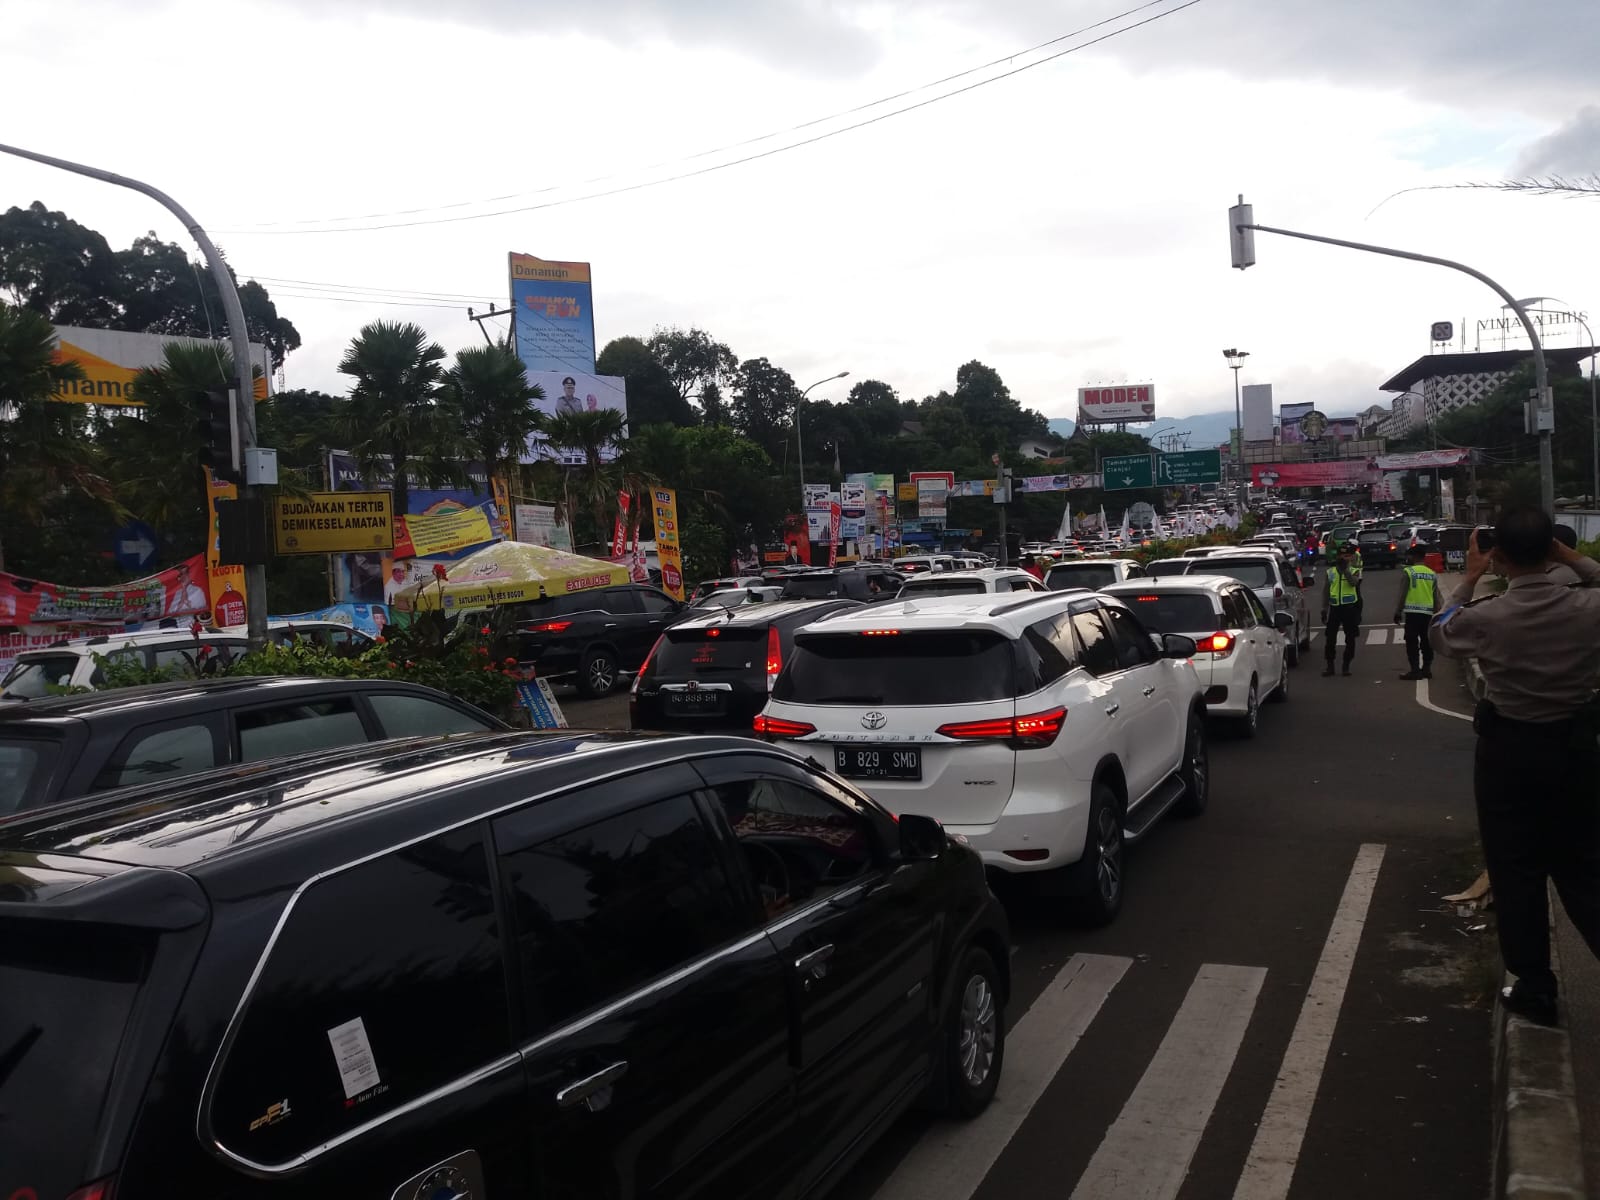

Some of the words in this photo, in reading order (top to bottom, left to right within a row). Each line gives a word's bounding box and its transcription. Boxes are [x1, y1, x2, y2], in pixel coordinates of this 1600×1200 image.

[515, 264, 569, 278] Danamon
[1084, 387, 1149, 406] MODEN
[282, 502, 344, 515] BUDAYAKAN
[348, 501, 384, 512] TERTIB
[282, 517, 386, 530] DEMIKESELAMATAN
[212, 566, 242, 577] KUOTA
[838, 751, 848, 767] B
[857, 752, 881, 768] 829
[892, 752, 918, 768] SMD
